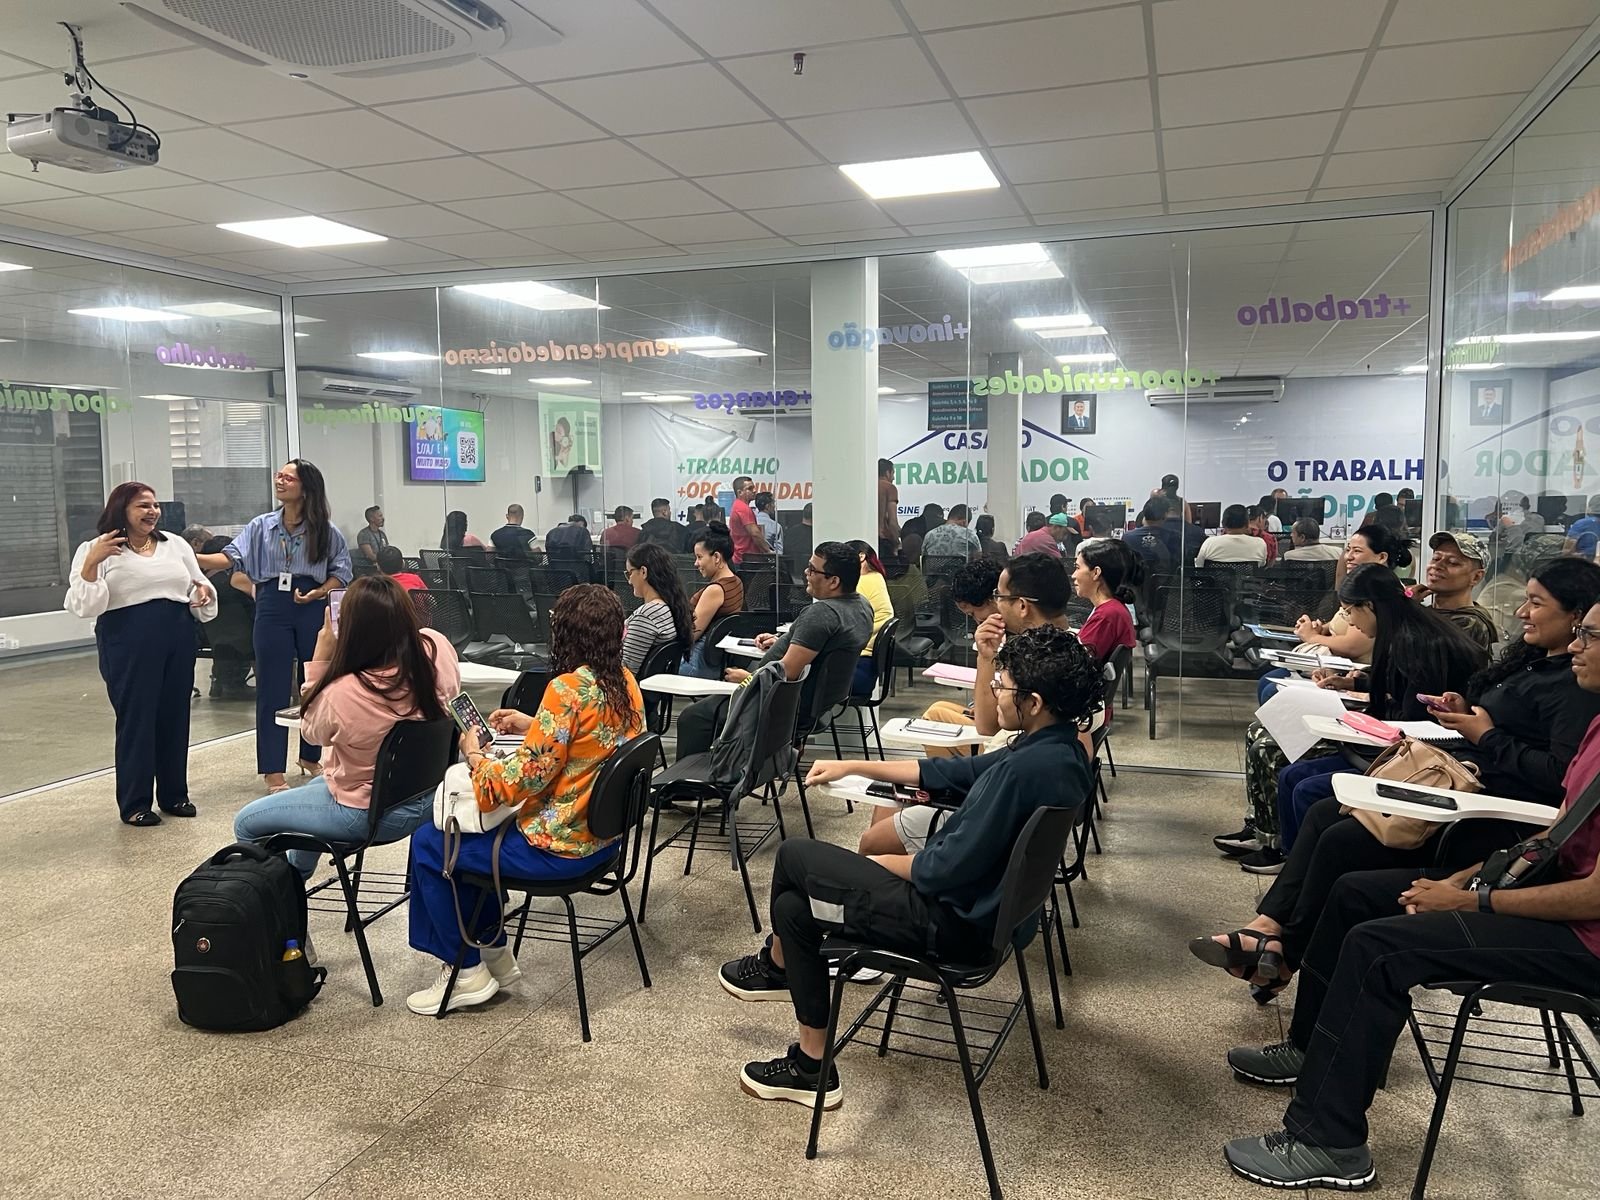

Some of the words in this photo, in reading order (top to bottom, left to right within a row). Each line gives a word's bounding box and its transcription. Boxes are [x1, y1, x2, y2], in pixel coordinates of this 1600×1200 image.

[677, 457, 780, 475] +TRABALHO
[1267, 460, 1288, 482] O
[897, 505, 920, 515] SINE
[1335, 528, 1341, 536] 6
